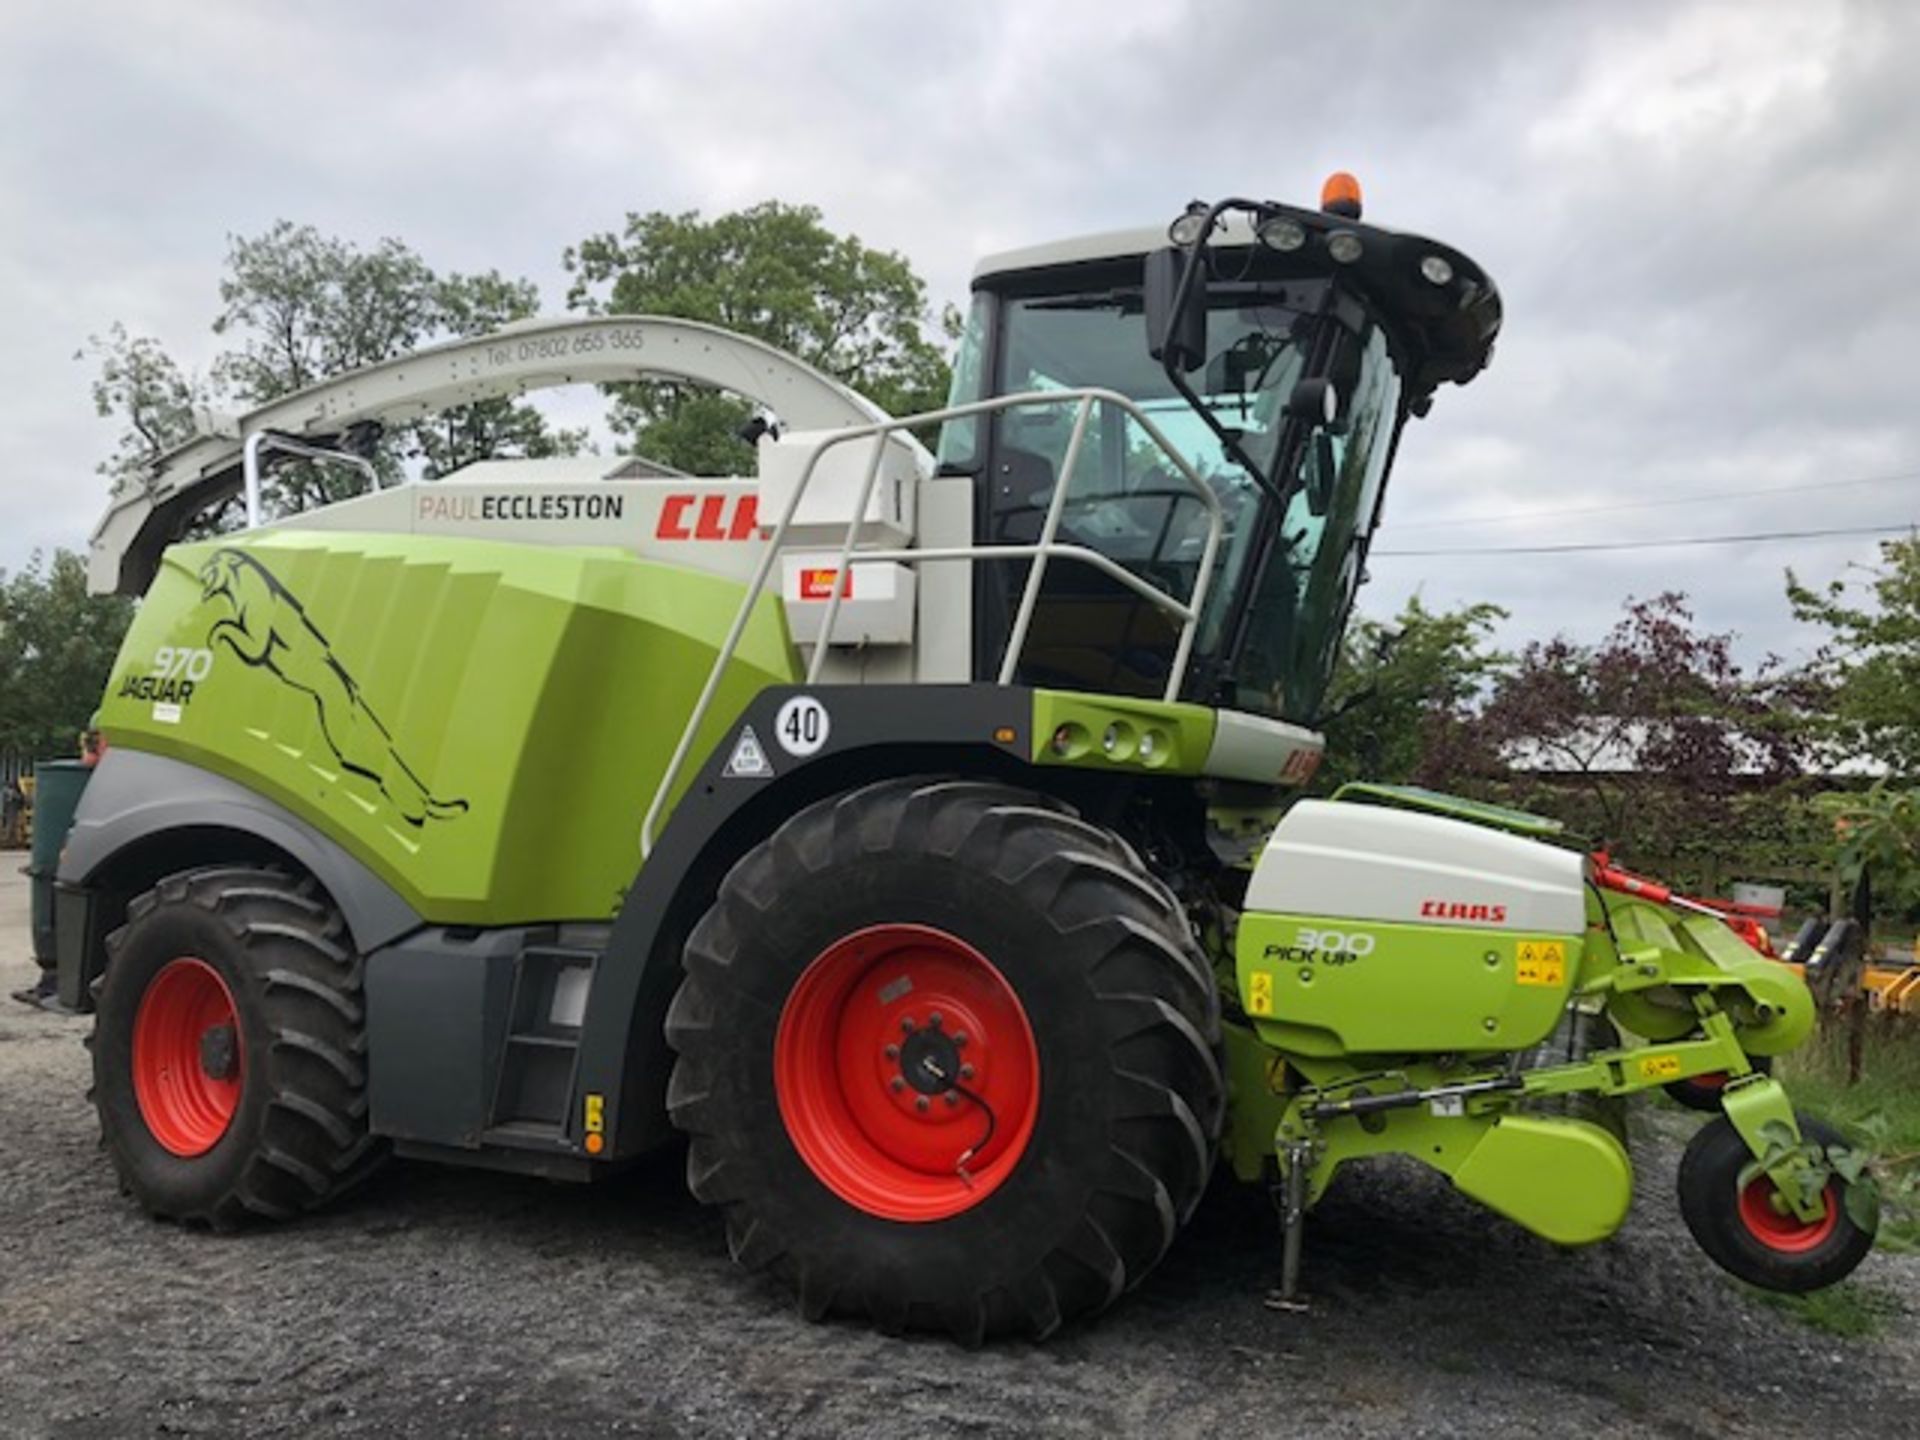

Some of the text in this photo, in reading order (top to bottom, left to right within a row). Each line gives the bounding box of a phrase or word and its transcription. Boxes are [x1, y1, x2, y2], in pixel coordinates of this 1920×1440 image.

[151, 646, 215, 682] 970
[118, 676, 195, 705] JAGUAR
[785, 706, 819, 743] 40
[1421, 901, 1507, 922] CLAAS
[1262, 944, 1358, 967] PICK UP
[1296, 927, 1376, 956] 300
